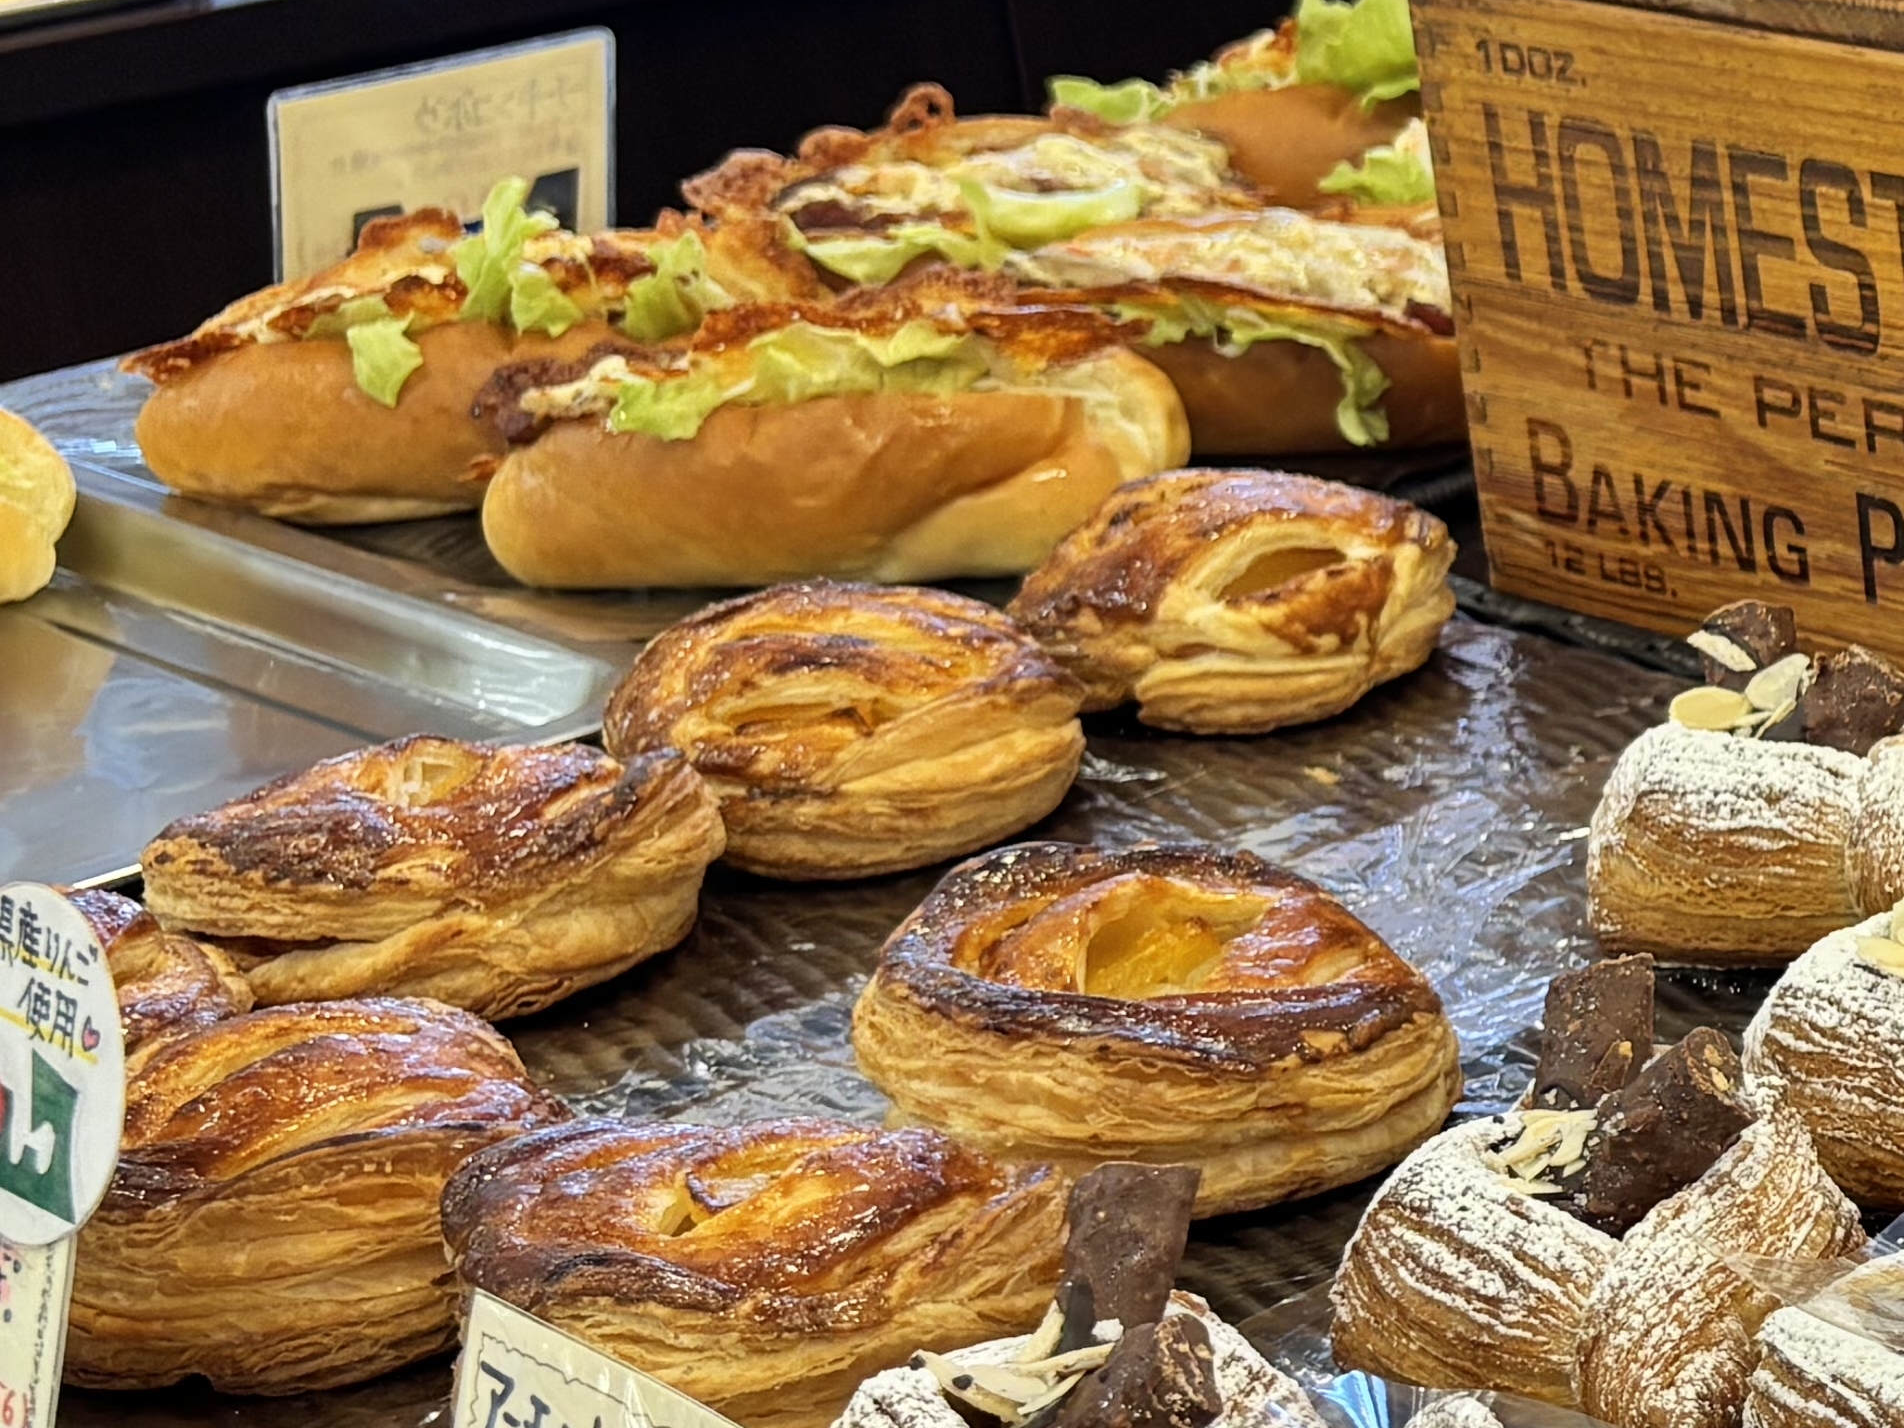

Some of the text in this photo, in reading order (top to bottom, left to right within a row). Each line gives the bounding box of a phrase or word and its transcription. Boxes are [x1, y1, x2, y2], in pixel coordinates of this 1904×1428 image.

[1584, 338, 1721, 420] THE
[1526, 417, 1810, 587] BAKING
[1545, 540, 1586, 576] 12
[16, 976, 78, 1053] 使用
